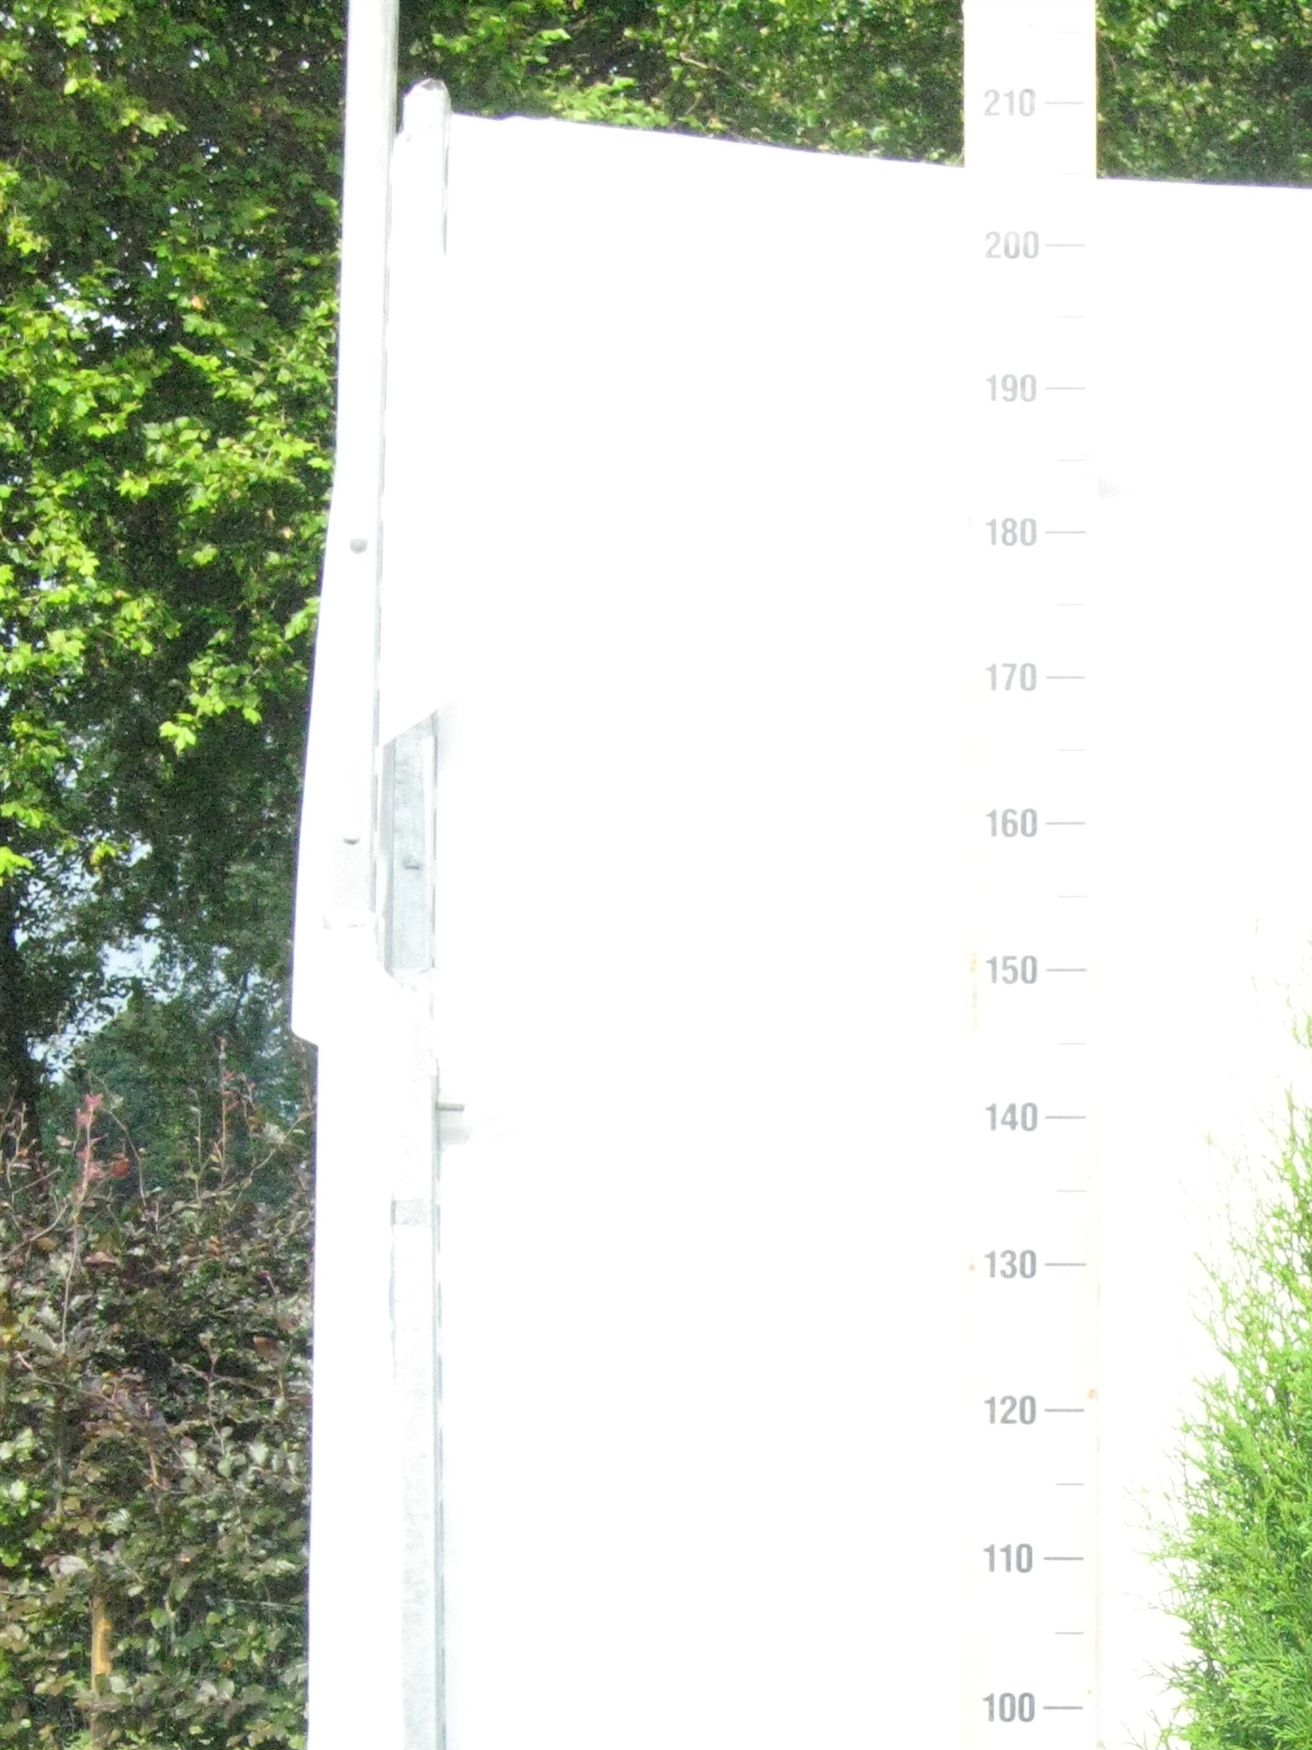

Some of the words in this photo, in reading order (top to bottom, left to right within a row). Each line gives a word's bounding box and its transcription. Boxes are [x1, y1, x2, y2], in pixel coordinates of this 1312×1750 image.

[983, 87, 1036, 117] 210
[985, 230, 1040, 260] 200
[985, 373, 1037, 403] 190
[985, 517, 1038, 547] 180
[985, 662, 1037, 692] 170
[985, 807, 1038, 838] 160
[985, 954, 1038, 985] 150
[984, 1101, 1039, 1133] 140
[983, 1248, 1038, 1280] 130
[983, 1394, 1037, 1426] 120
[982, 1542, 1034, 1574] 110
[981, 1691, 1036, 1723] 100
